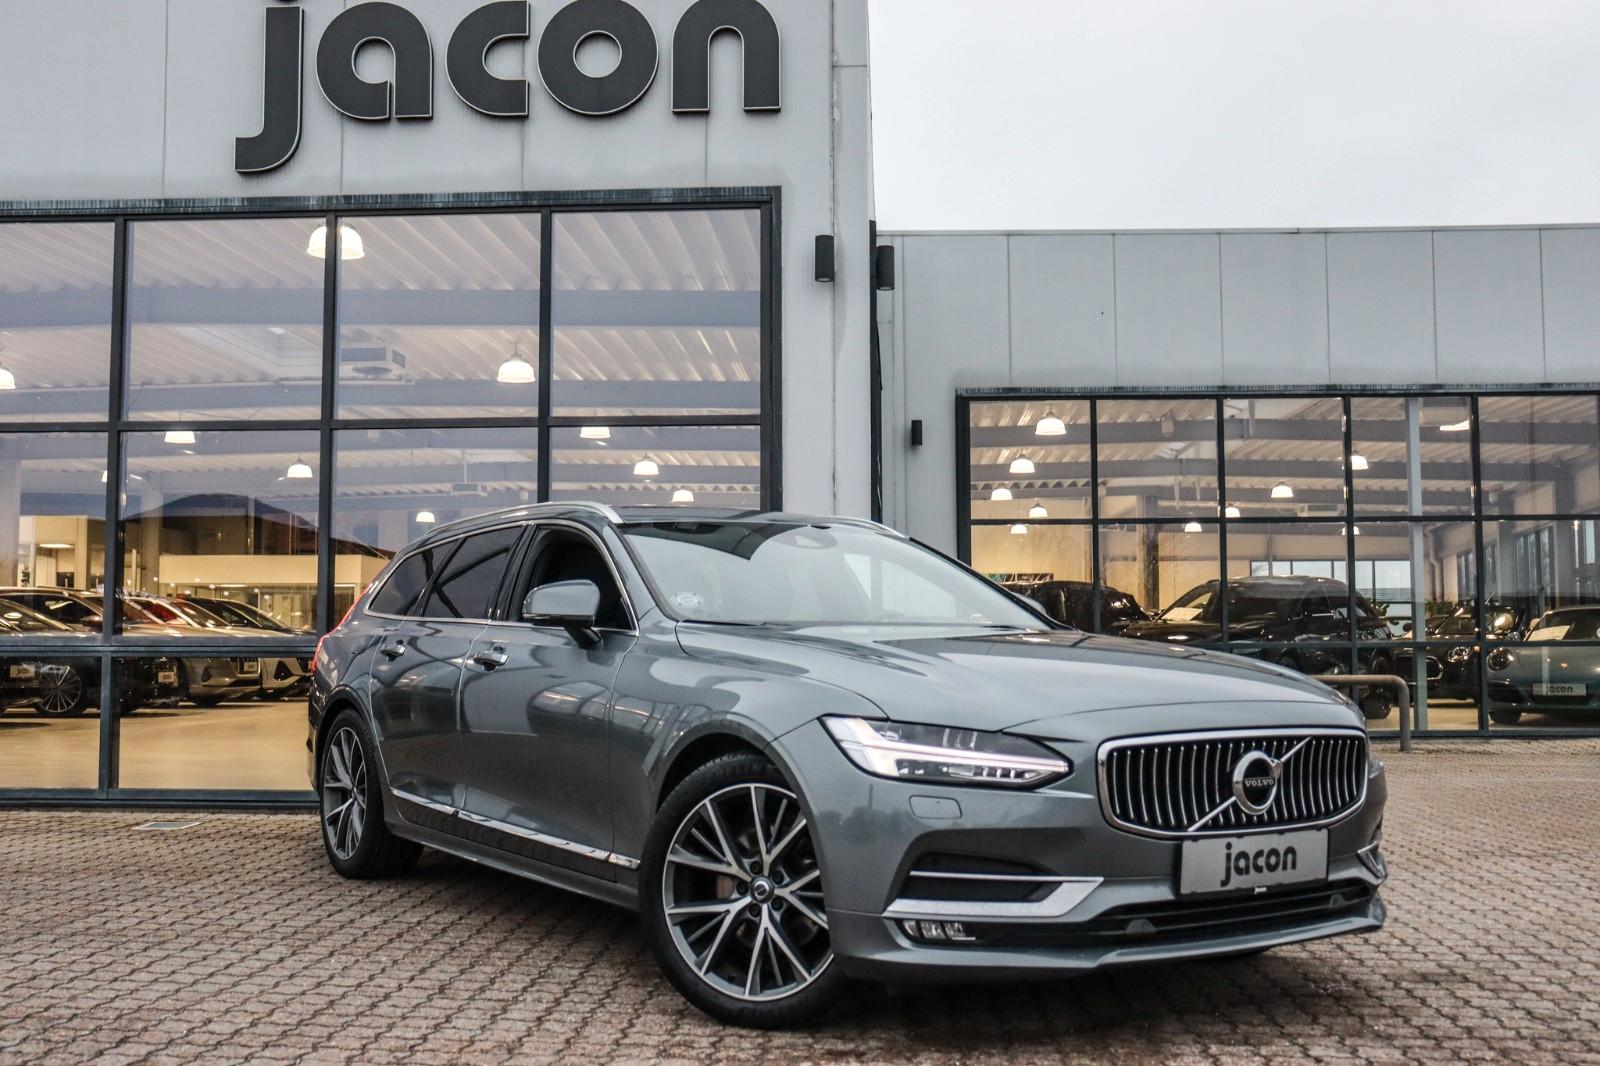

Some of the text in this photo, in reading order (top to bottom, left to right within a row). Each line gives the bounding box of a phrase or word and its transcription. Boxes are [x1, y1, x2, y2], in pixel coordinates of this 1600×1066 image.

[234, 0, 781, 174] jacon
[1244, 779, 1274, 787] VOLVO
[1220, 841, 1297, 887] jacon
